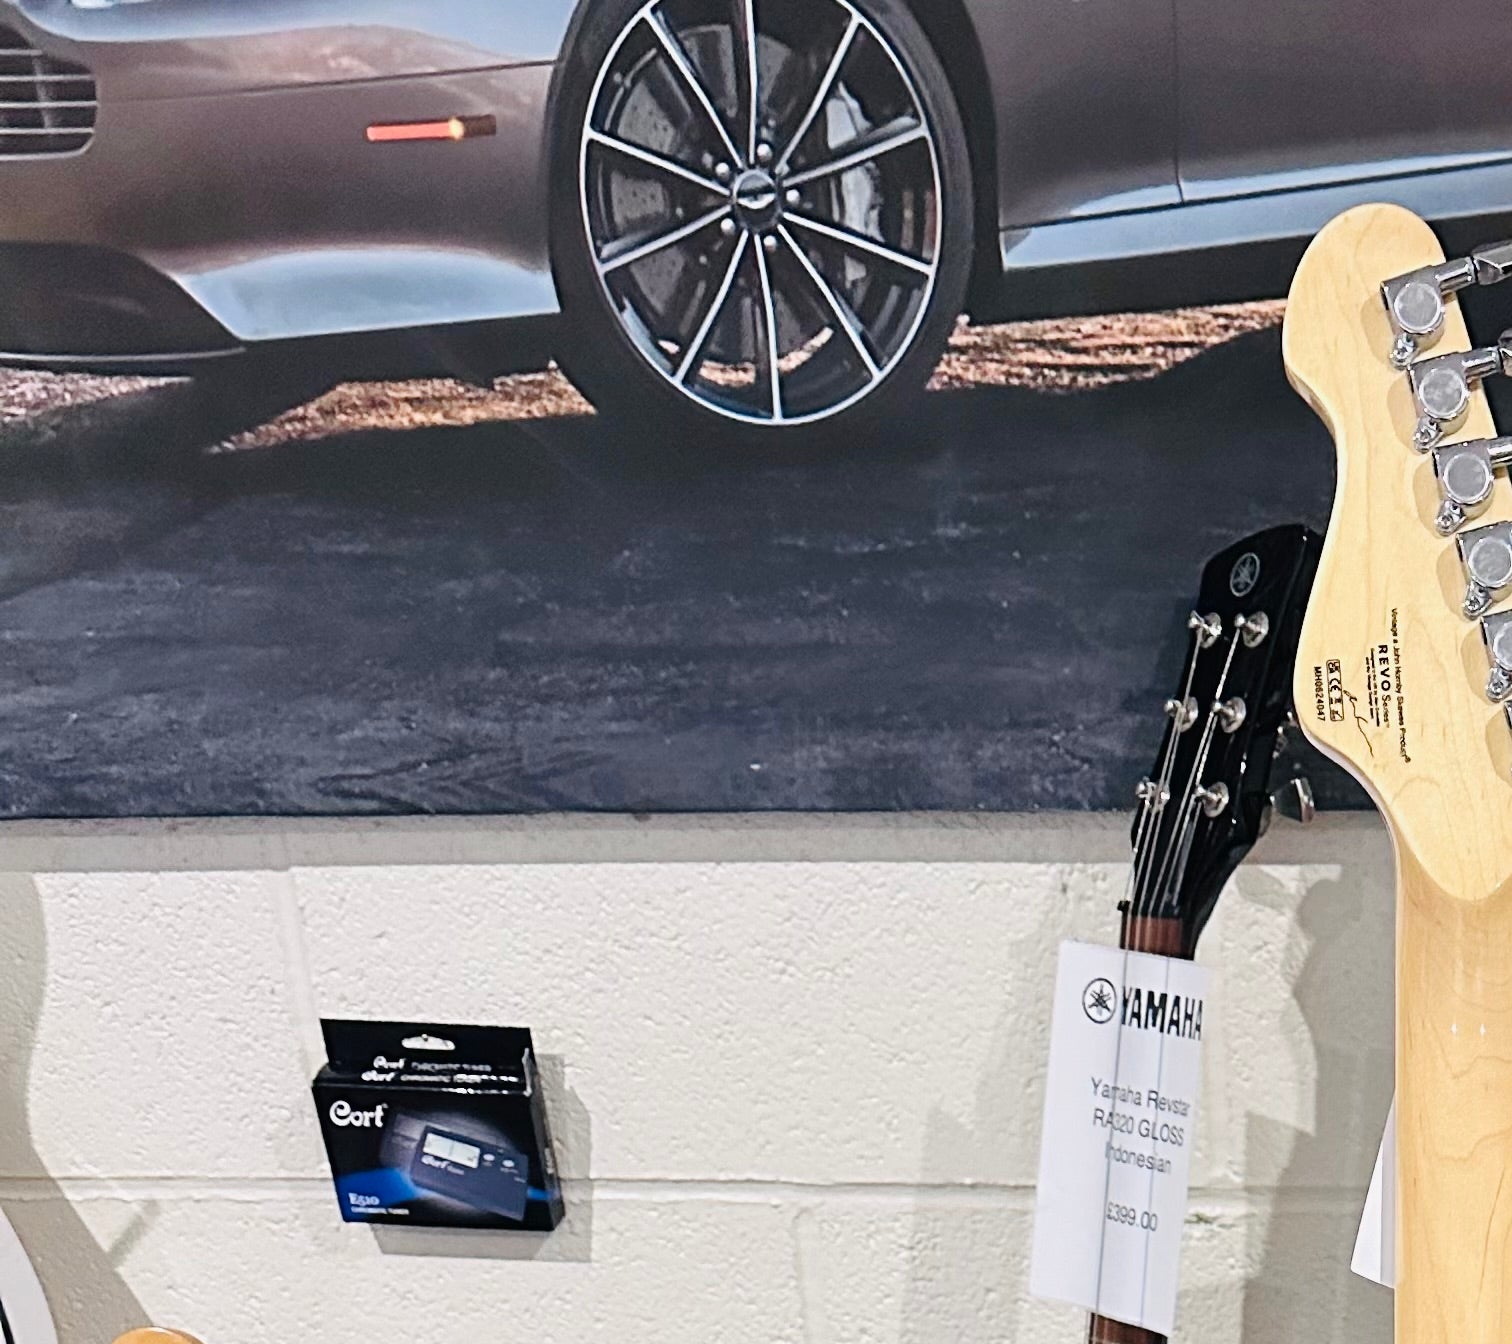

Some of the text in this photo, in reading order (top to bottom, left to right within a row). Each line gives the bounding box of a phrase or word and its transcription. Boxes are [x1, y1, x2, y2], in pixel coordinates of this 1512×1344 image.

[1378, 644, 1391, 692] REVO
[1121, 986, 1203, 1041] YAMAHA
[329, 1100, 385, 1127] Cort
[1091, 1077, 1191, 1117] Yamaha Revstar
[1138, 1119, 1185, 1147] GLOSS
[1105, 1141, 1171, 1174] Indonesian
[1106, 1202, 1158, 1232] £399.00
